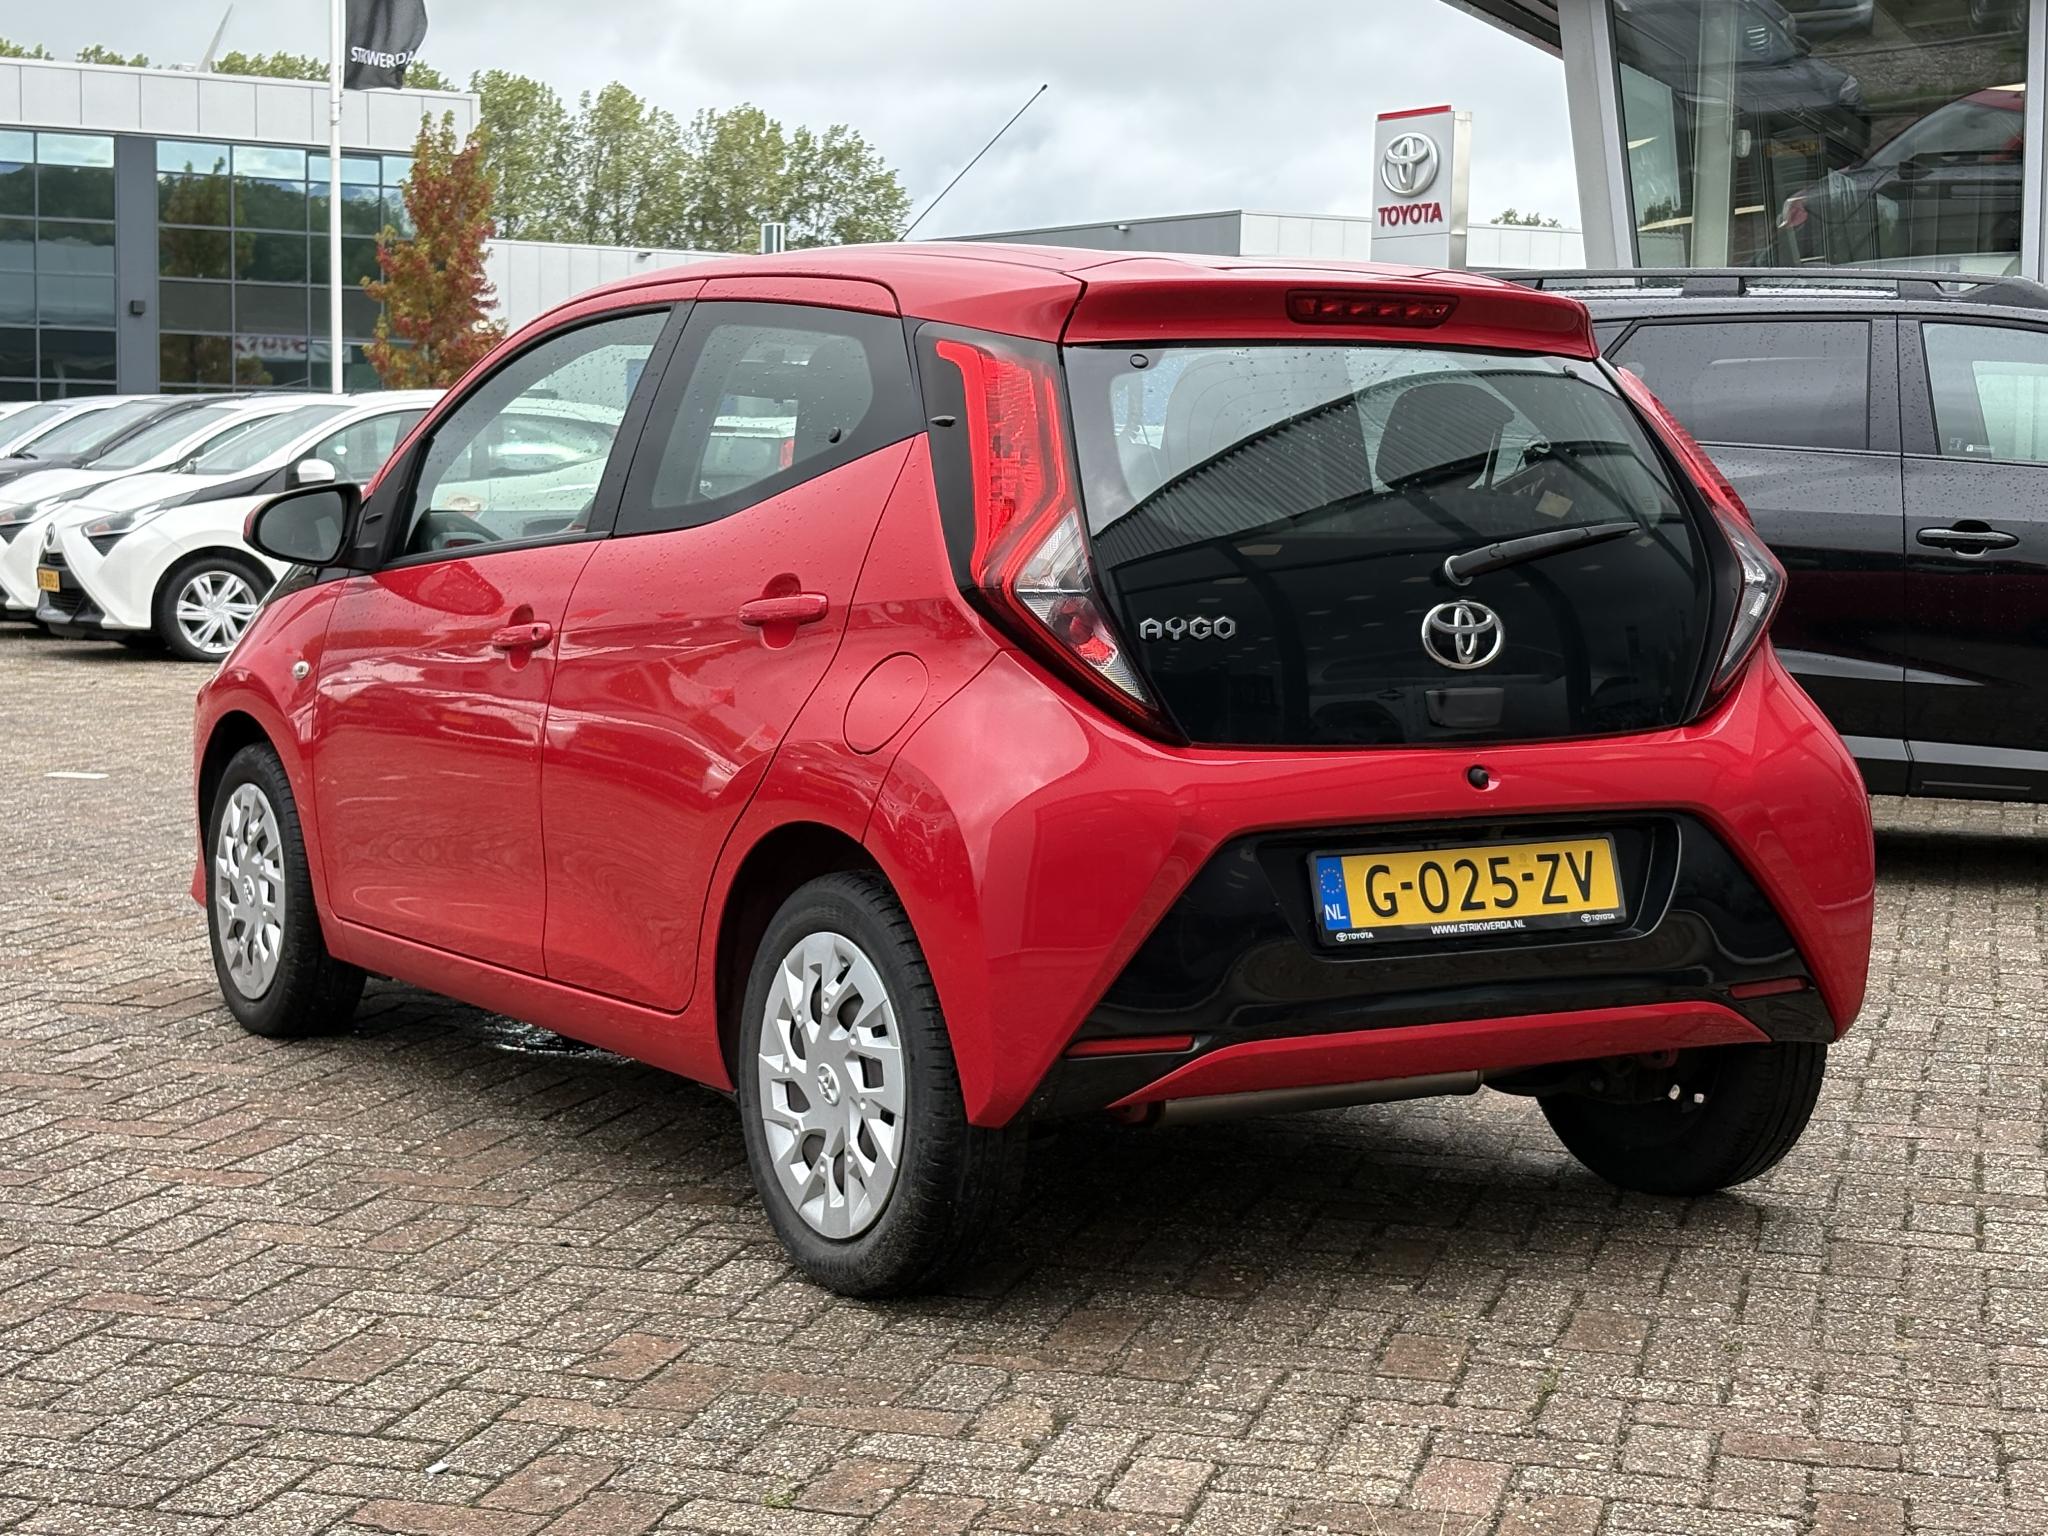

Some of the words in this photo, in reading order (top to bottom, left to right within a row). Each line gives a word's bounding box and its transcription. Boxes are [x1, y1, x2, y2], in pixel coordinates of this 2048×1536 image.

[350, 46, 414, 68] STKWERDA
[1377, 202, 1443, 227] TOYOTA
[1139, 616, 1236, 641] AYGO
[1324, 903, 1347, 921] NL
[1364, 850, 1594, 918] G-025-ZV
[1347, 931, 1374, 940] TOYOTA
[1430, 919, 1527, 935] WWW.STRIKWERDA.NL
[1591, 912, 1616, 921] TOYOTA
